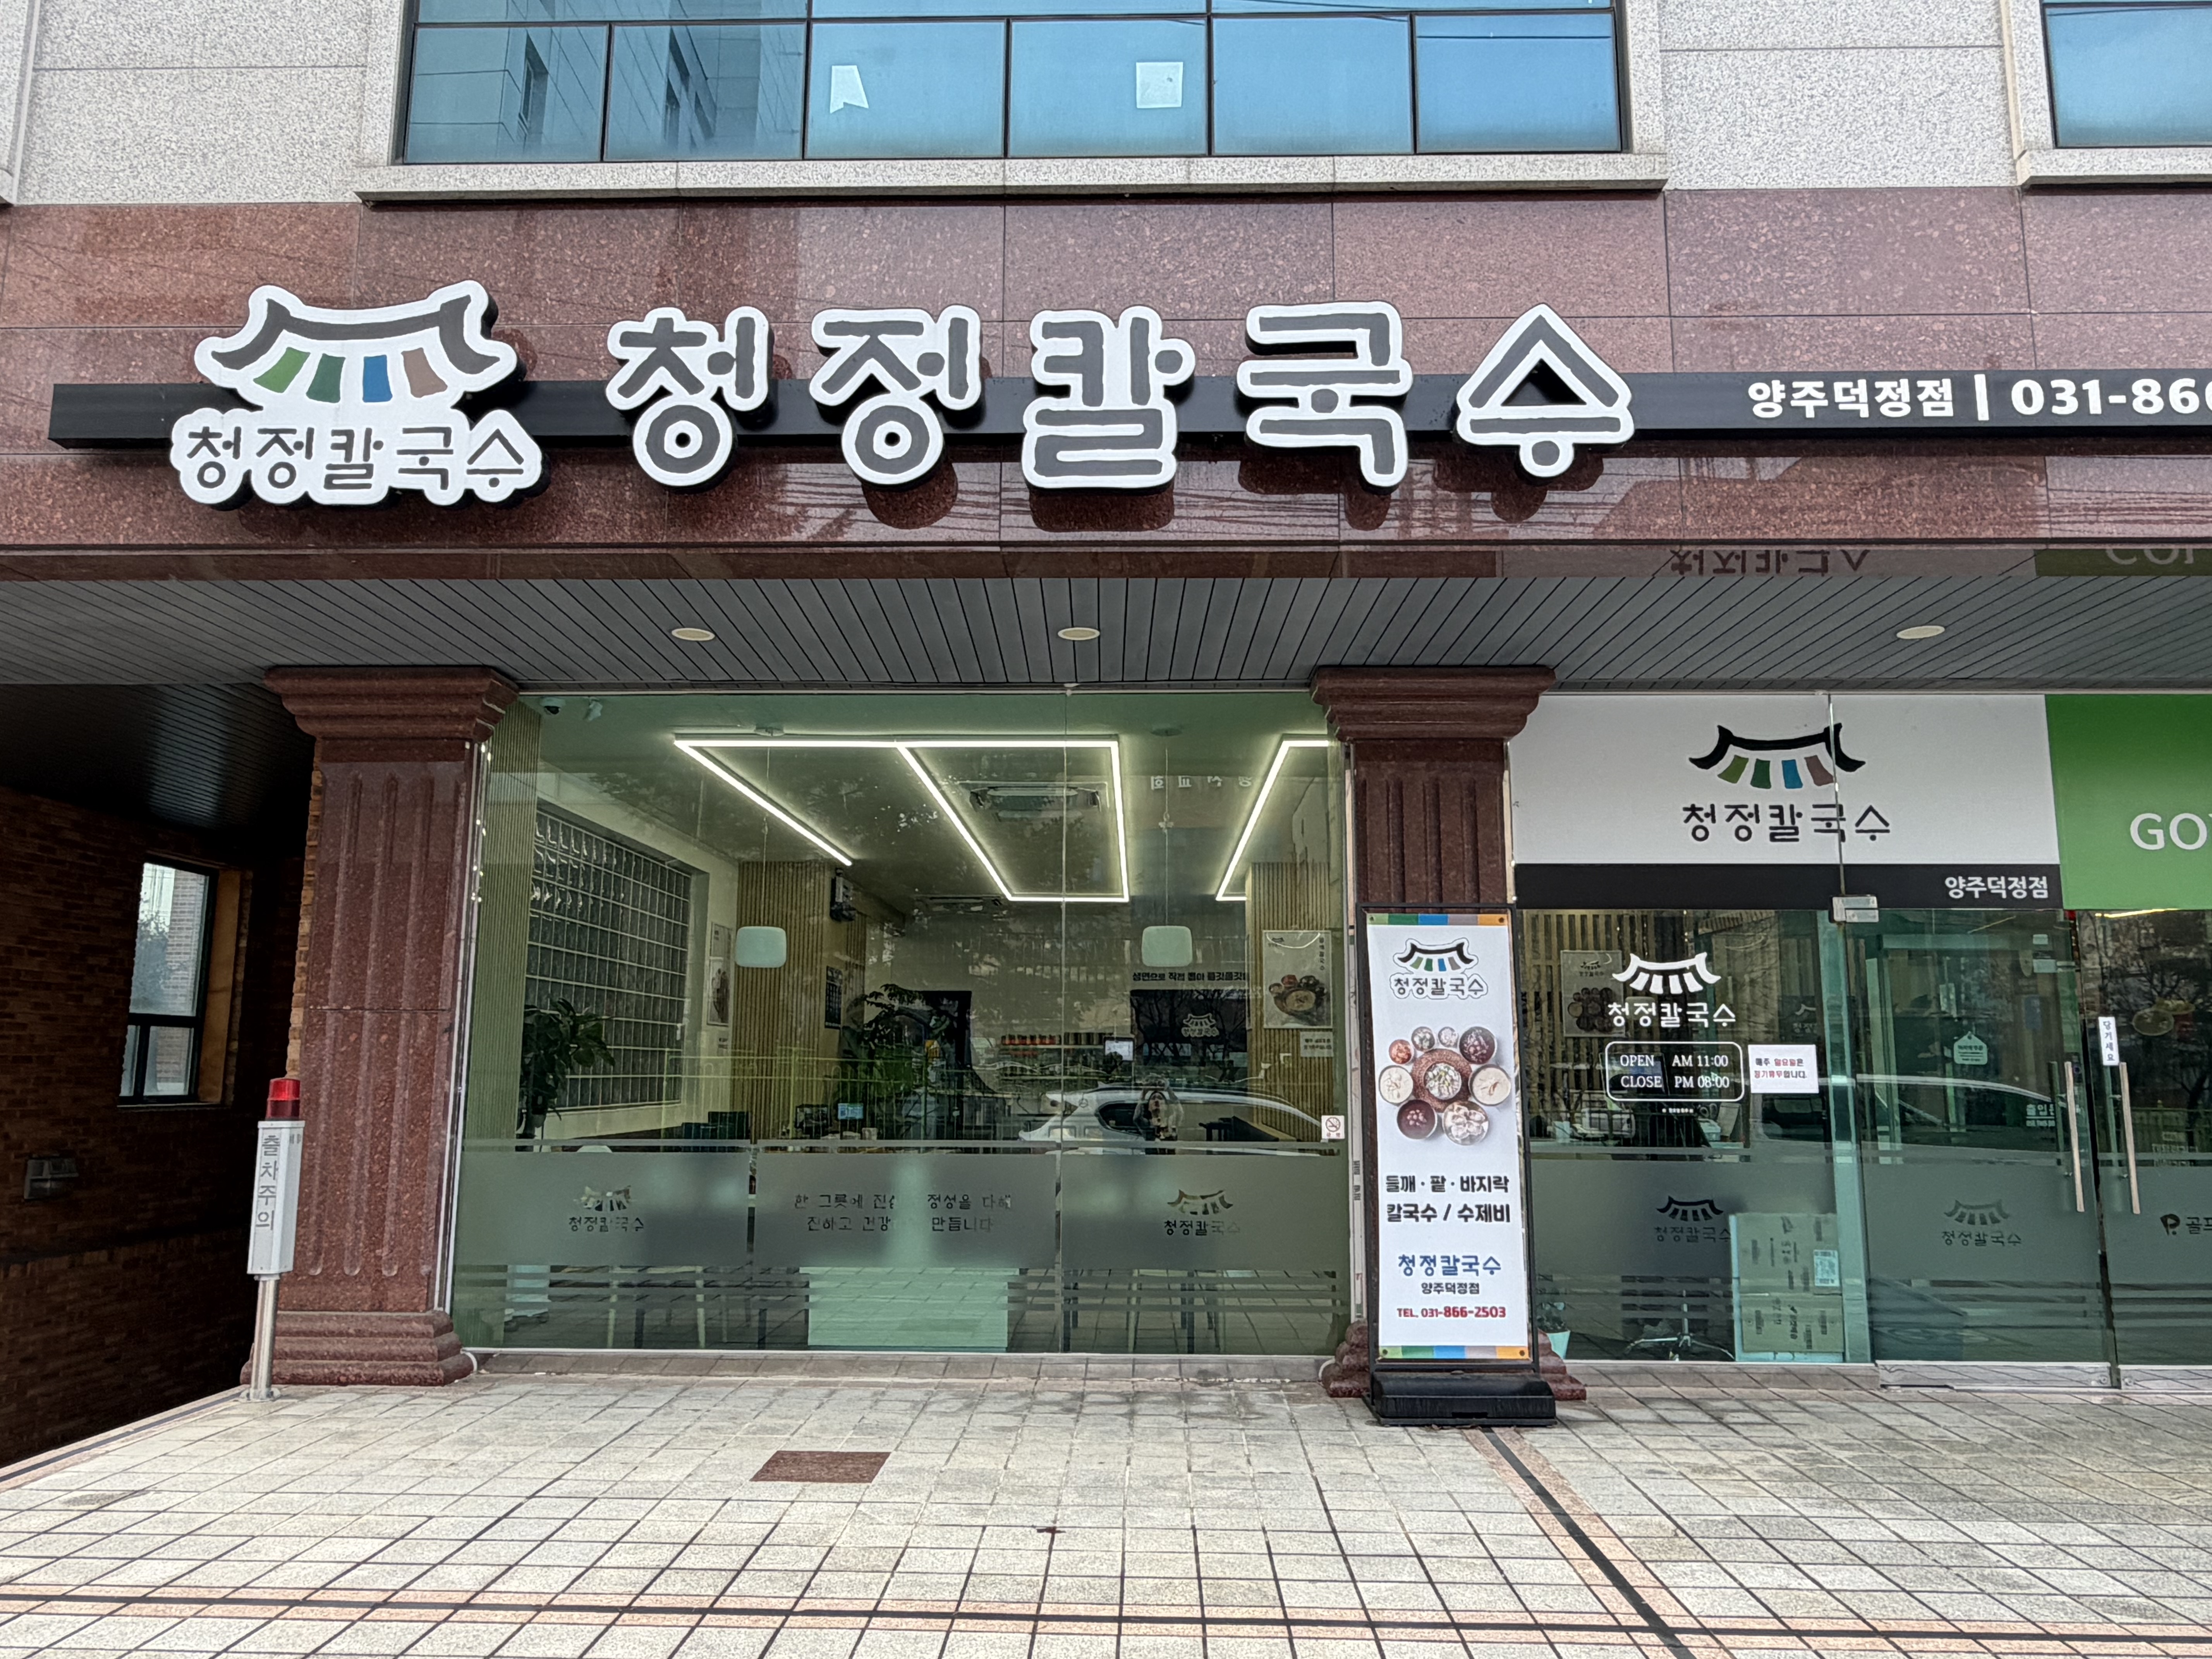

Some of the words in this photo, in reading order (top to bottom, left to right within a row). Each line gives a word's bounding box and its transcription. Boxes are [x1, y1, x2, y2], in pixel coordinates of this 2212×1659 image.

[606, 304, 1634, 487] 청정칼국수
[1748, 378, 1954, 419] 양주덕정점
[2011, 378, 2212, 416] 031-86
[187, 426, 524, 490] 청정칼국수
[1682, 803, 1890, 842] 청정칼국수
[2130, 812, 2212, 850] GO
[1945, 876, 2049, 899] 양주덕정점
[1393, 977, 1484, 996] 청정칼국수
[1608, 1002, 1736, 1028] 청정칼국수
[2103, 1020, 2115, 1061] 당기세요
[1620, 1054, 1654, 1067] OPEN
[1671, 1054, 1693, 1067] AM
[1697, 1055, 1729, 1067] 11:00
[1620, 1075, 1662, 1088] CLOSE
[1674, 1076, 1694, 1088] PM
[1697, 1075, 1730, 1088] 08:00
[255, 1135, 280, 1231] 출차주의
[1385, 1175, 1416, 1193] 들깨
[1430, 1175, 1446, 1193] 팥
[1460, 1175, 1510, 1193] 바지락
[795, 1194, 809, 1209] 한
[818, 1194, 863, 1209] 그릇에
[927, 1194, 971, 1210] 정성을
[1386, 1203, 1437, 1223] 칼국수
[1457, 1203, 1510, 1223] 수제비
[807, 1216, 852, 1231] 진하고
[932, 1216, 994, 1232] 만듭니다
[1164, 1219, 1240, 1236] 청정칼국수
[1654, 1226, 1731, 1243] 청정칼국수
[1398, 1254, 1501, 1277] 청정칼국수
[1421, 1283, 1480, 1295] 양주덕정점
[1396, 1307, 1419, 1318] TEL.
[1420, 1305, 1506, 1318] 031-866-2503
